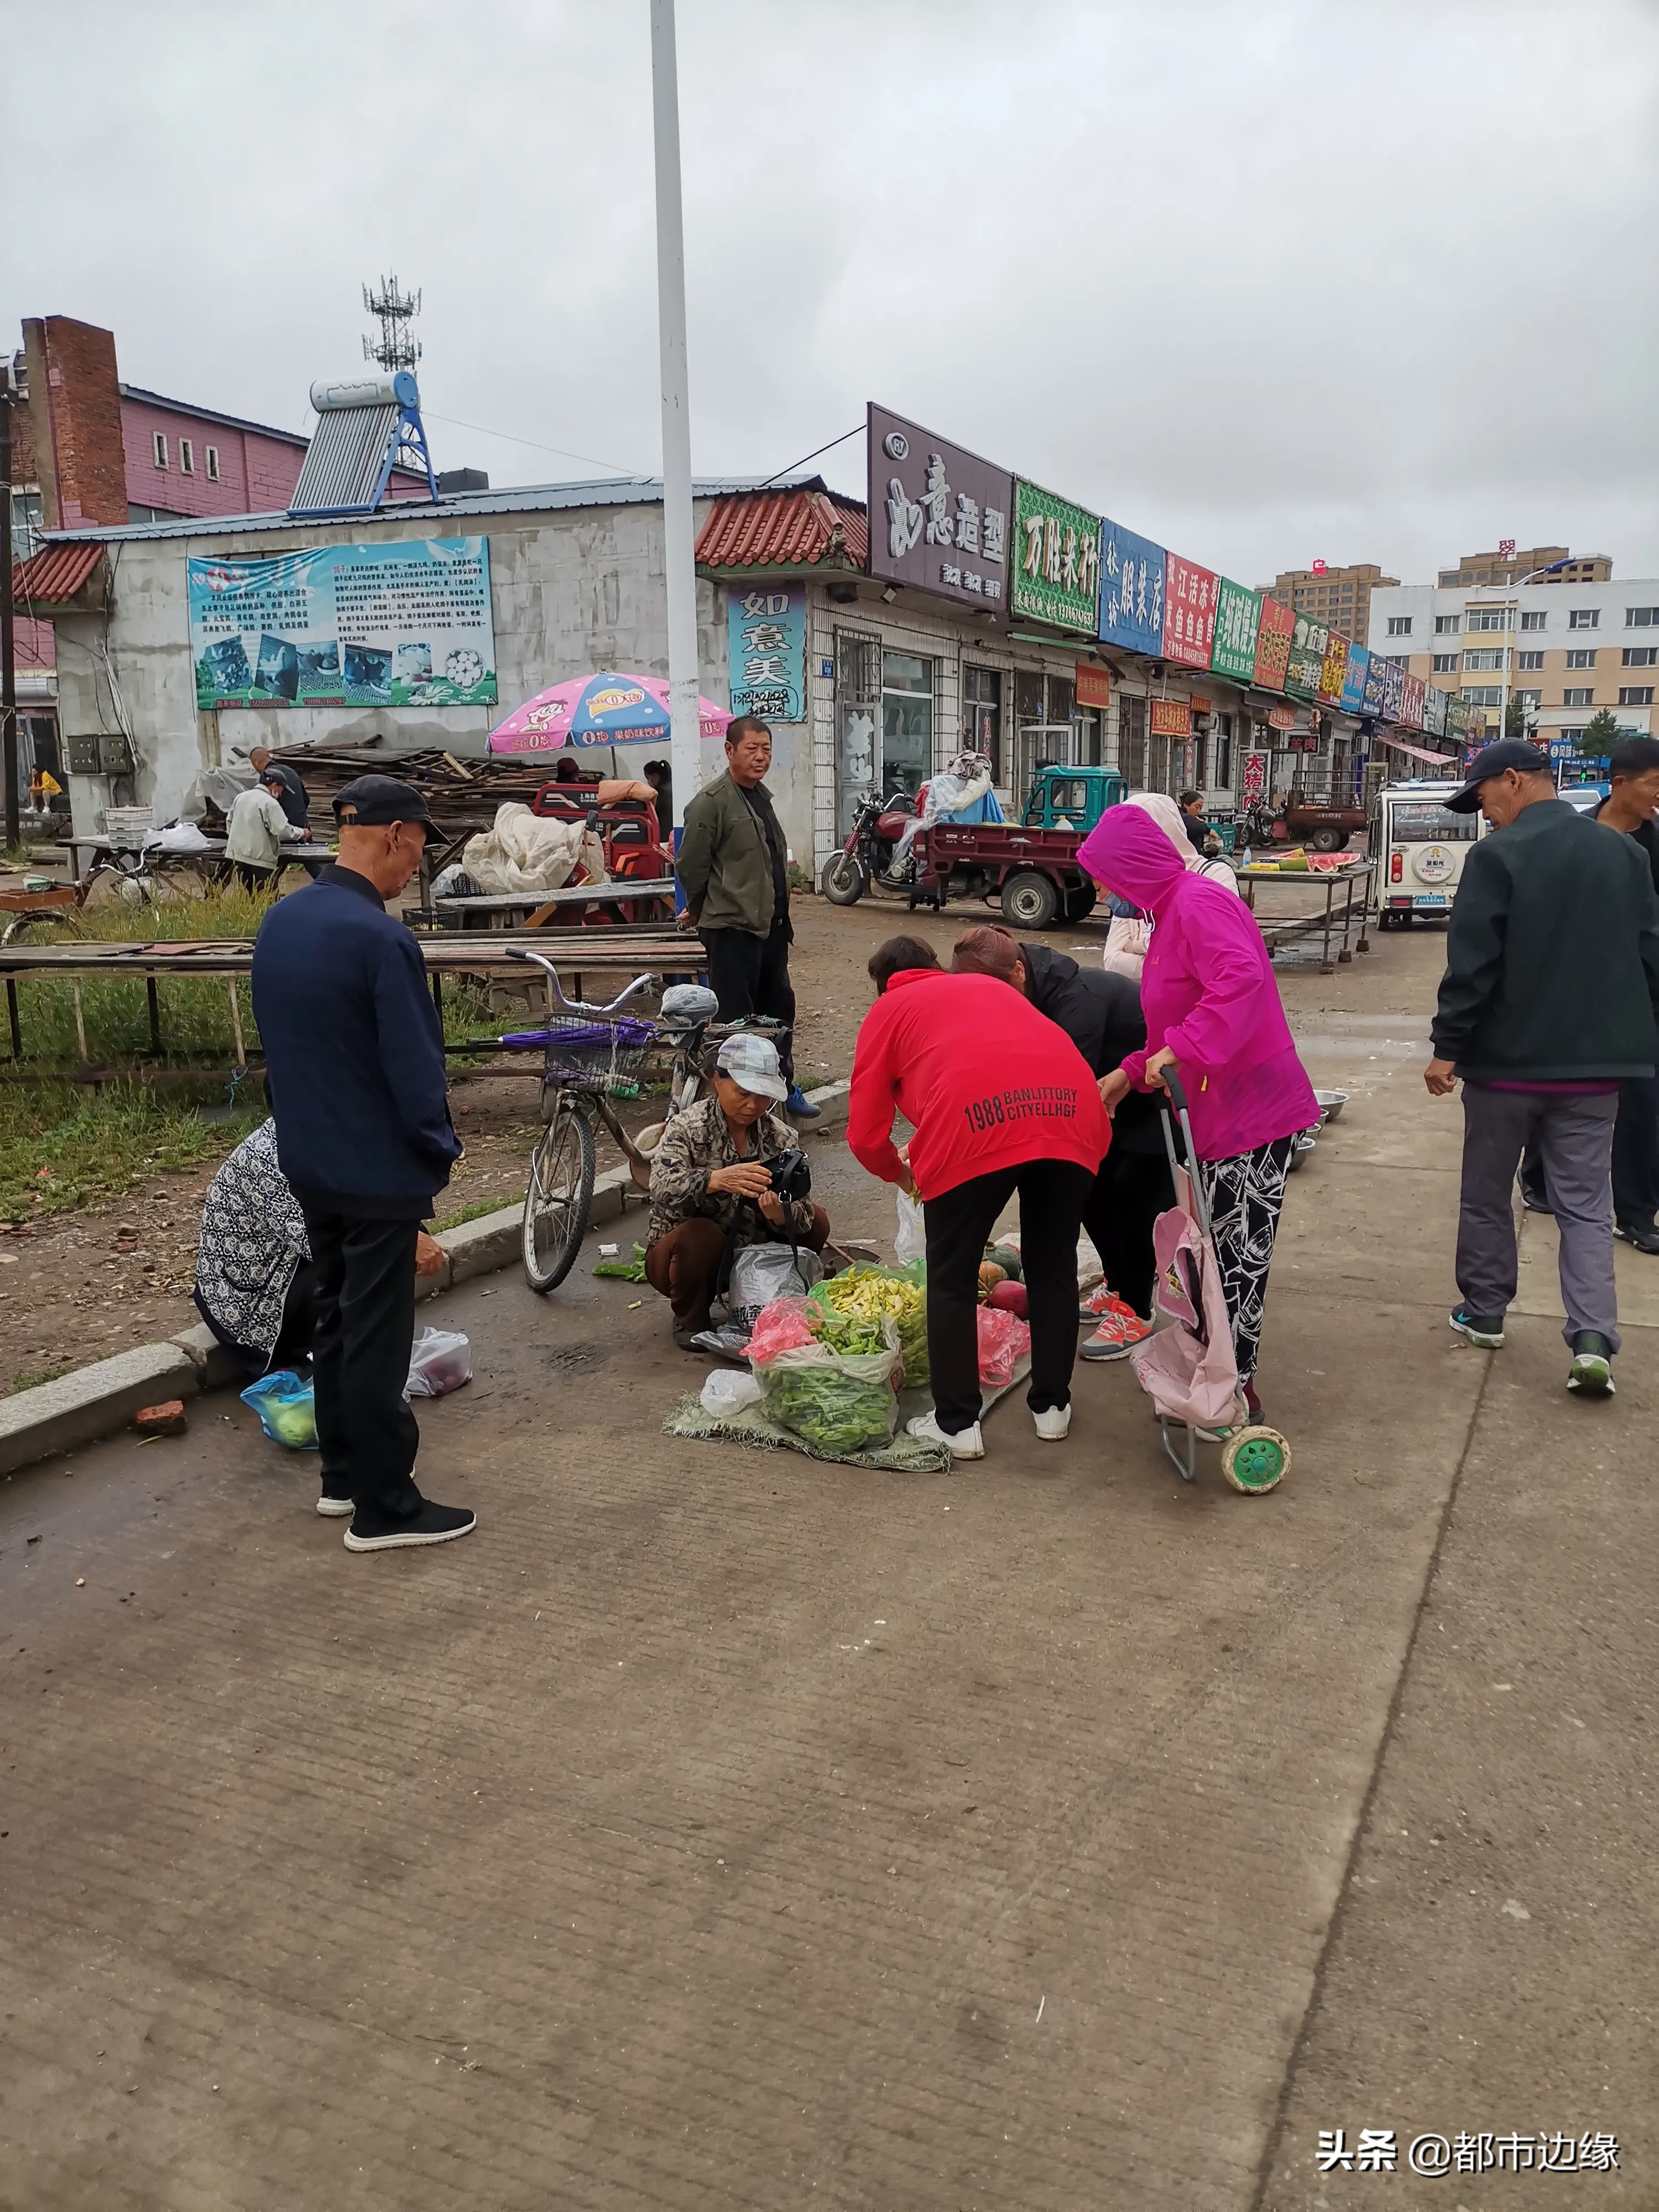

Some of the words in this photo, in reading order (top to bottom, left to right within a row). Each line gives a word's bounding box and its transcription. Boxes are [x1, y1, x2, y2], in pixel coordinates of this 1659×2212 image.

[884, 453, 1005, 564] 如意造型
[1022, 515, 1097, 597] 万胜米行
[1120, 559, 1162, 633] 服装店
[964, 1095, 1005, 1134] 1988
[1003, 1087, 1078, 1105] BANLITTORY
[1006, 1102, 1077, 1121] CITYELLHGF
